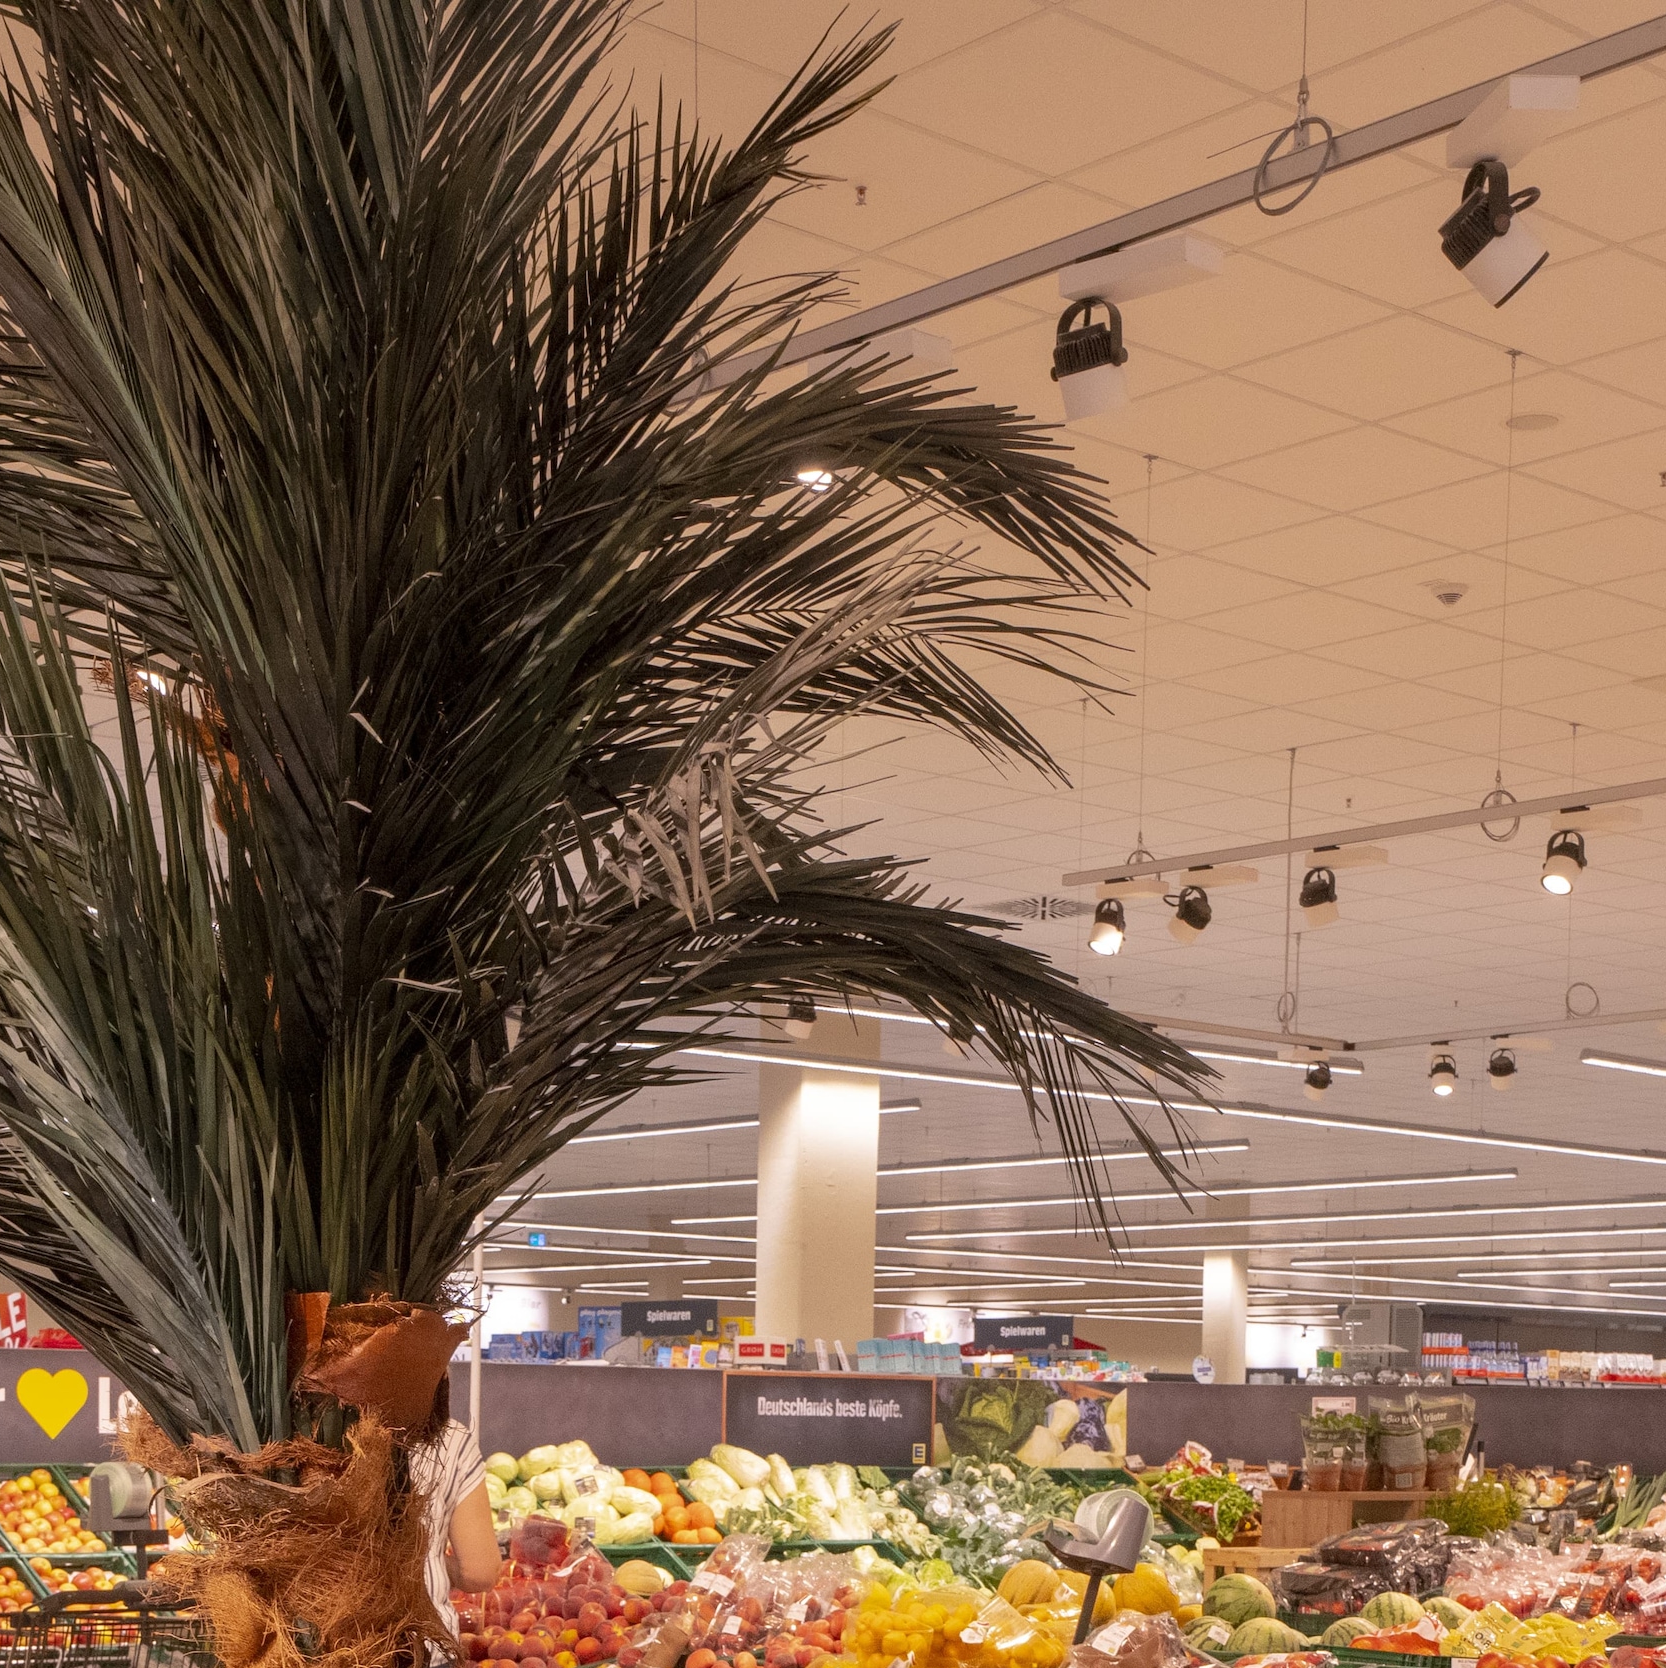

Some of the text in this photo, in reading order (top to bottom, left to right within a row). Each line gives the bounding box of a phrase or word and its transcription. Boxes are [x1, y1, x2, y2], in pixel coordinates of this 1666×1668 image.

[647, 1310, 691, 1323] Spielwaren
[1000, 1325, 1045, 1338] Spielwaren
[757, 1396, 903, 1422] Deutschlands beste Köpfe.
